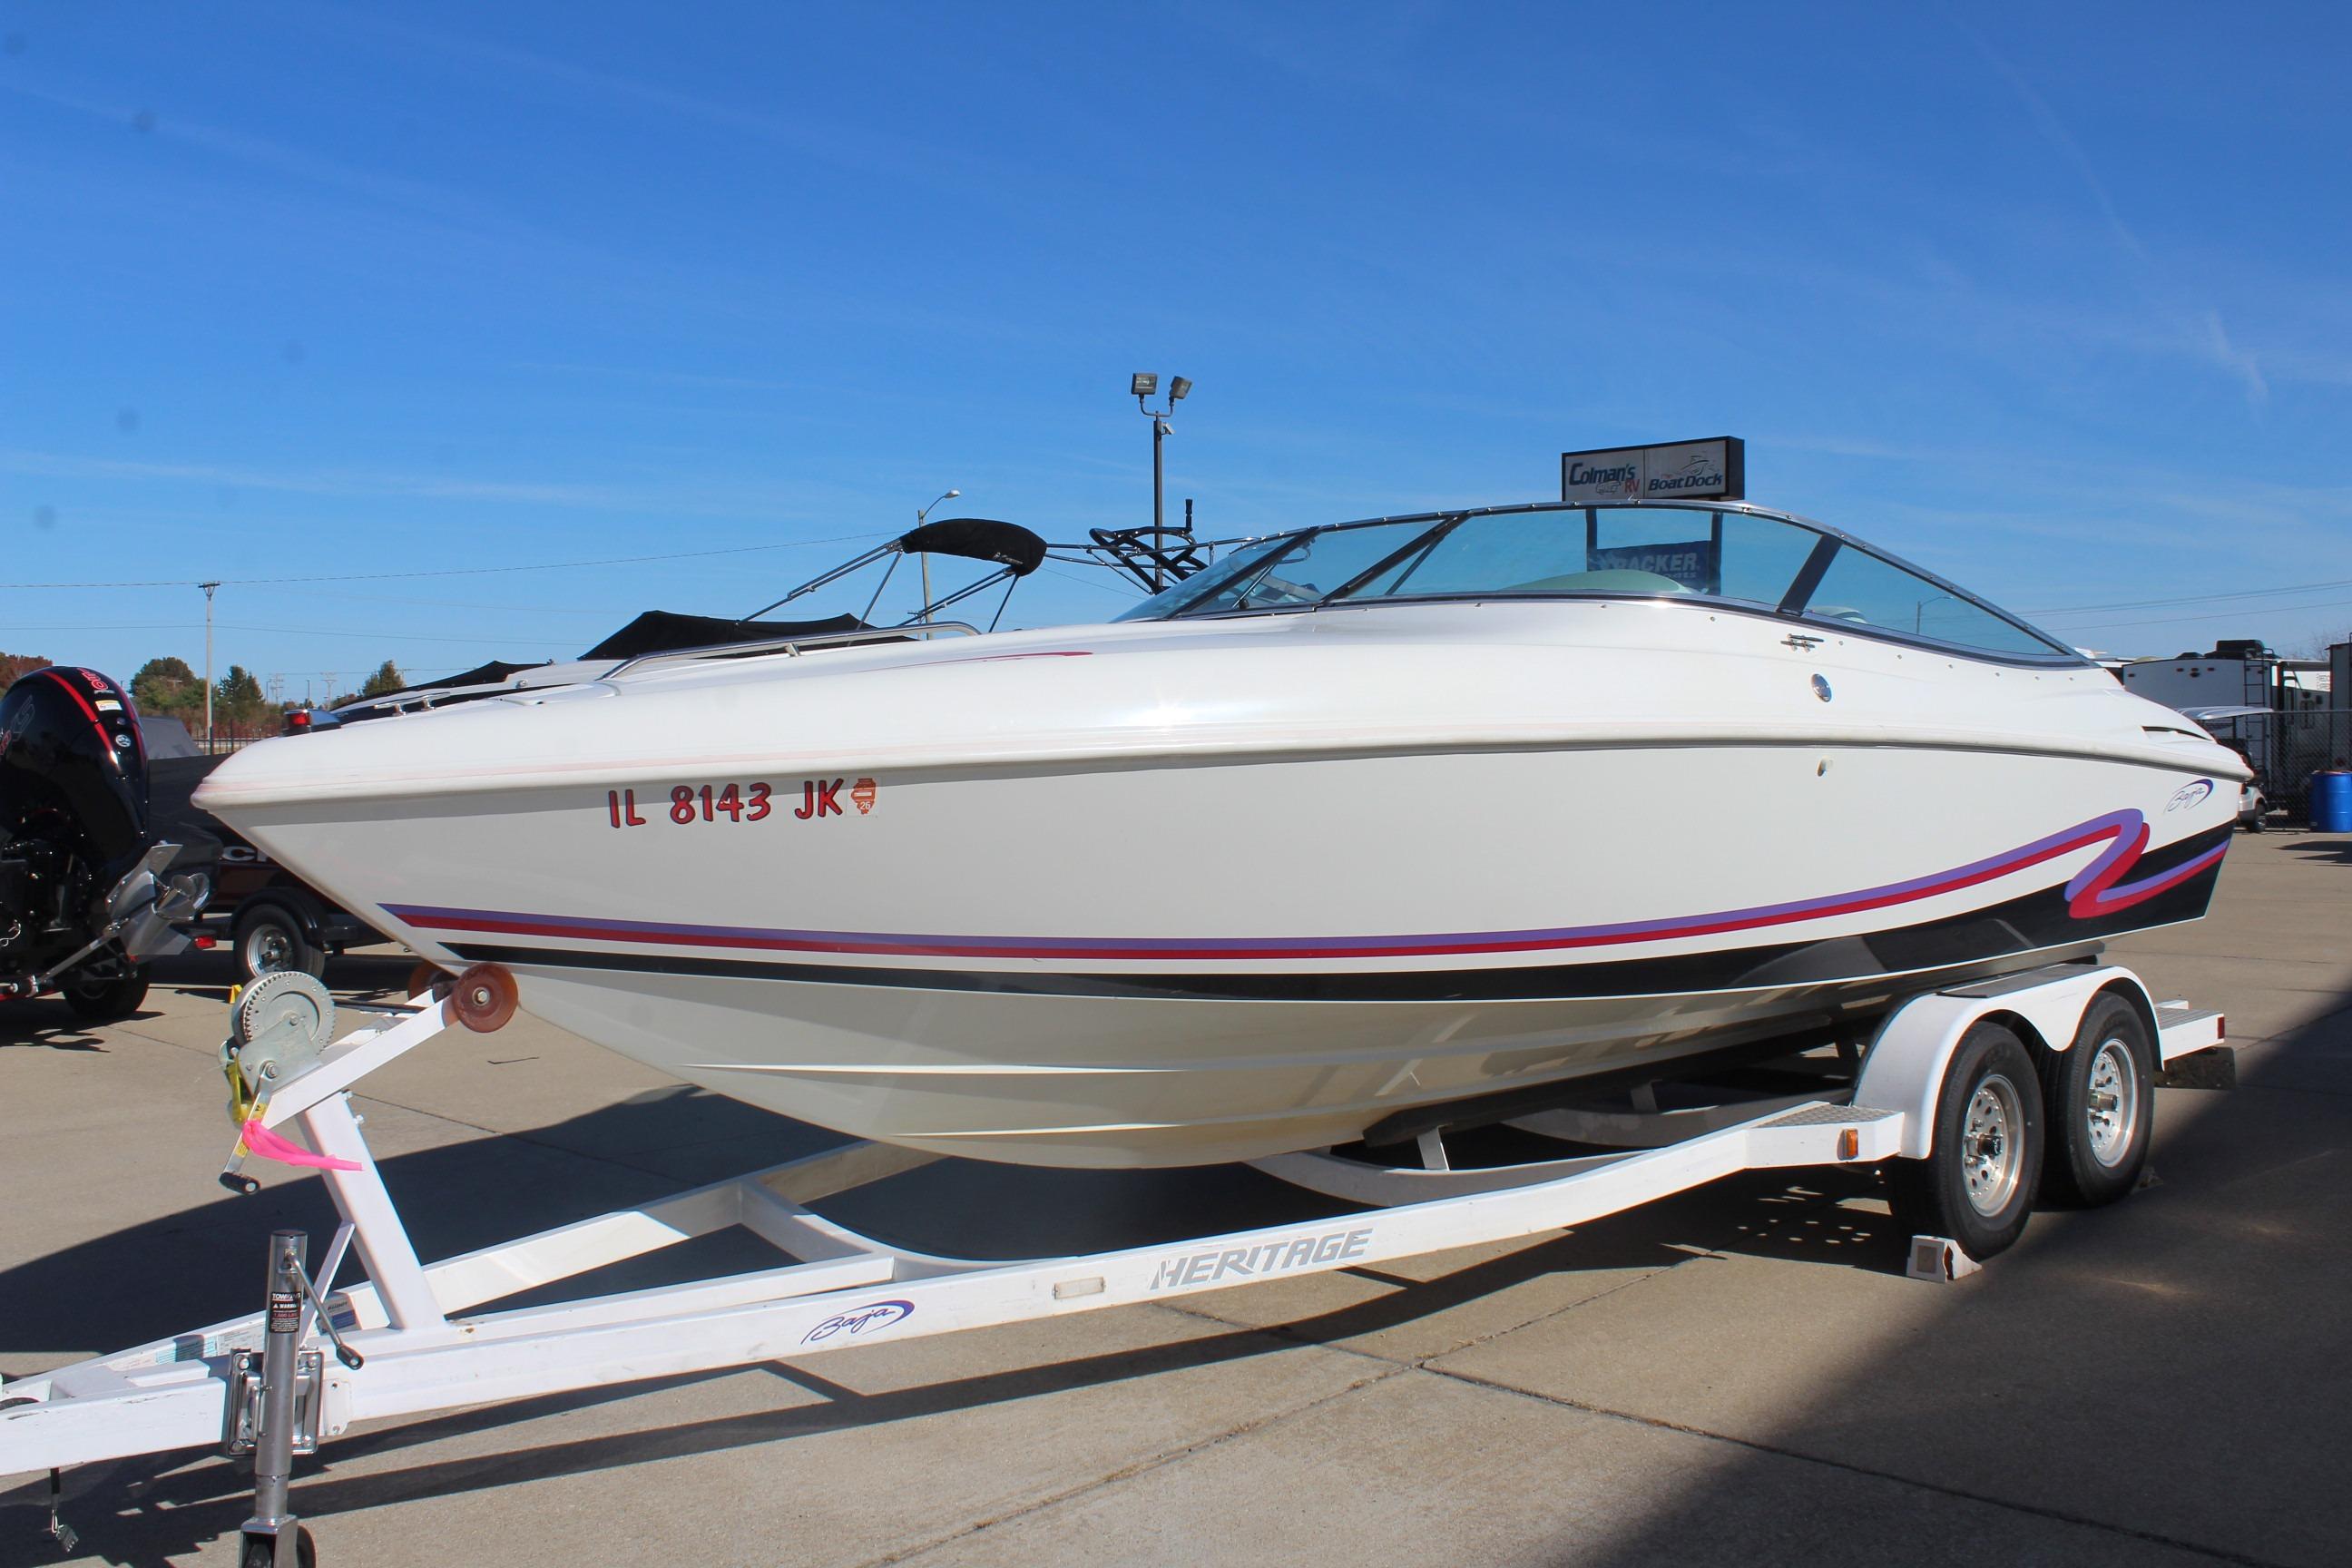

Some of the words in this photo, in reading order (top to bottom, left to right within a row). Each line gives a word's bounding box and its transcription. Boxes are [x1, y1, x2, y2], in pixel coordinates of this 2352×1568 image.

[1569, 462, 1636, 485] Colman's
[1625, 478, 1640, 494] RV
[1648, 477, 1684, 491] Boat
[1684, 473, 1722, 488] Dock
[608, 789, 646, 828] IL
[670, 782, 771, 825] 8143
[794, 778, 844, 820] JK
[1149, 1228, 1374, 1291] HERITAGE
[800, 1307, 897, 1345] Baja
